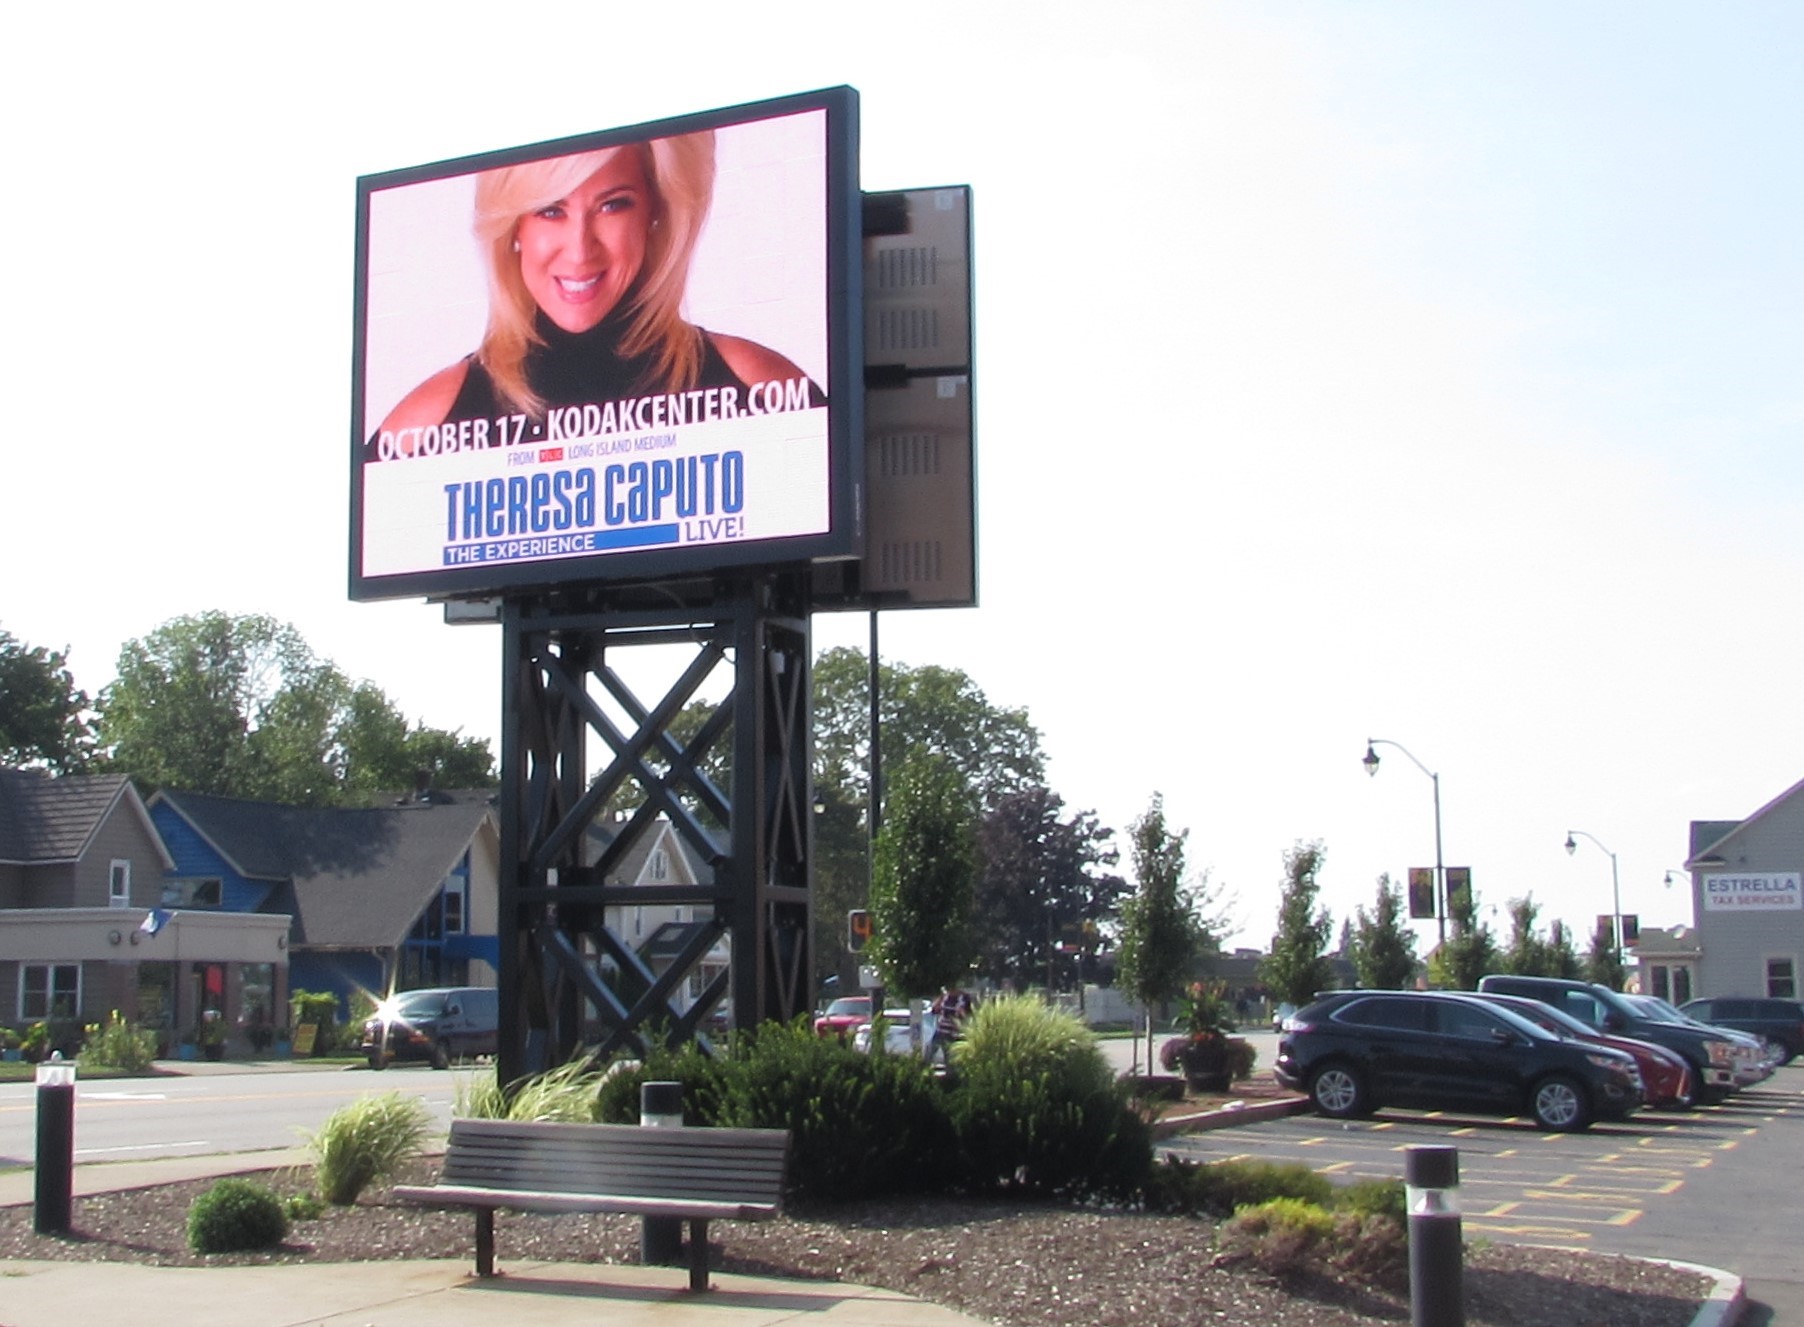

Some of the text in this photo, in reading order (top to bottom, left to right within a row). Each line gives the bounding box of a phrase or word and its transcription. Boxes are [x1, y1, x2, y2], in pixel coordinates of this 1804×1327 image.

[377, 418, 490, 462] OCTOBER
[495, 415, 526, 447] 17
[547, 376, 810, 441] KODAKCENTER.COM
[507, 451, 535, 466] FROM
[568, 442, 595, 460] LONG
[596, 436, 632, 456] ISLAND
[634, 433, 677, 451] MEDIUM
[448, 517, 744, 564] THE EXPERIENCE LIVE!
[1707, 878, 1796, 892] ESTRELLA
